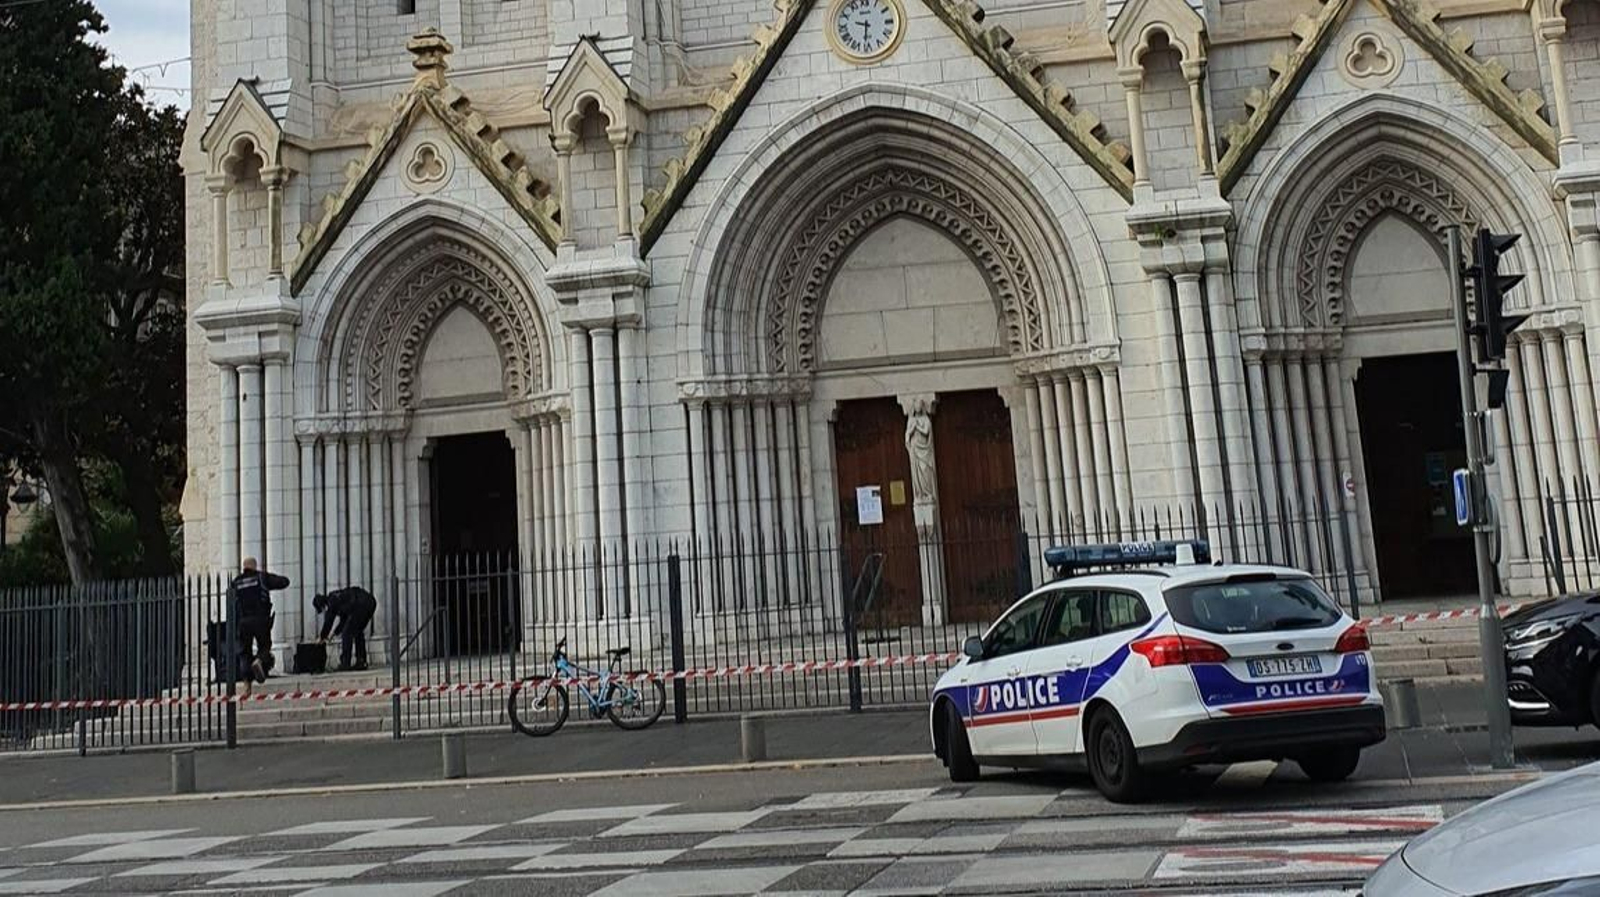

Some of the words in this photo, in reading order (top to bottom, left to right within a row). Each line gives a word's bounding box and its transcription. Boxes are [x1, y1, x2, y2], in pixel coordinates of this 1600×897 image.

[1122, 542, 1153, 554] POLICE
[990, 676, 1060, 711] POLICE
[1256, 680, 1326, 698] POLICE
